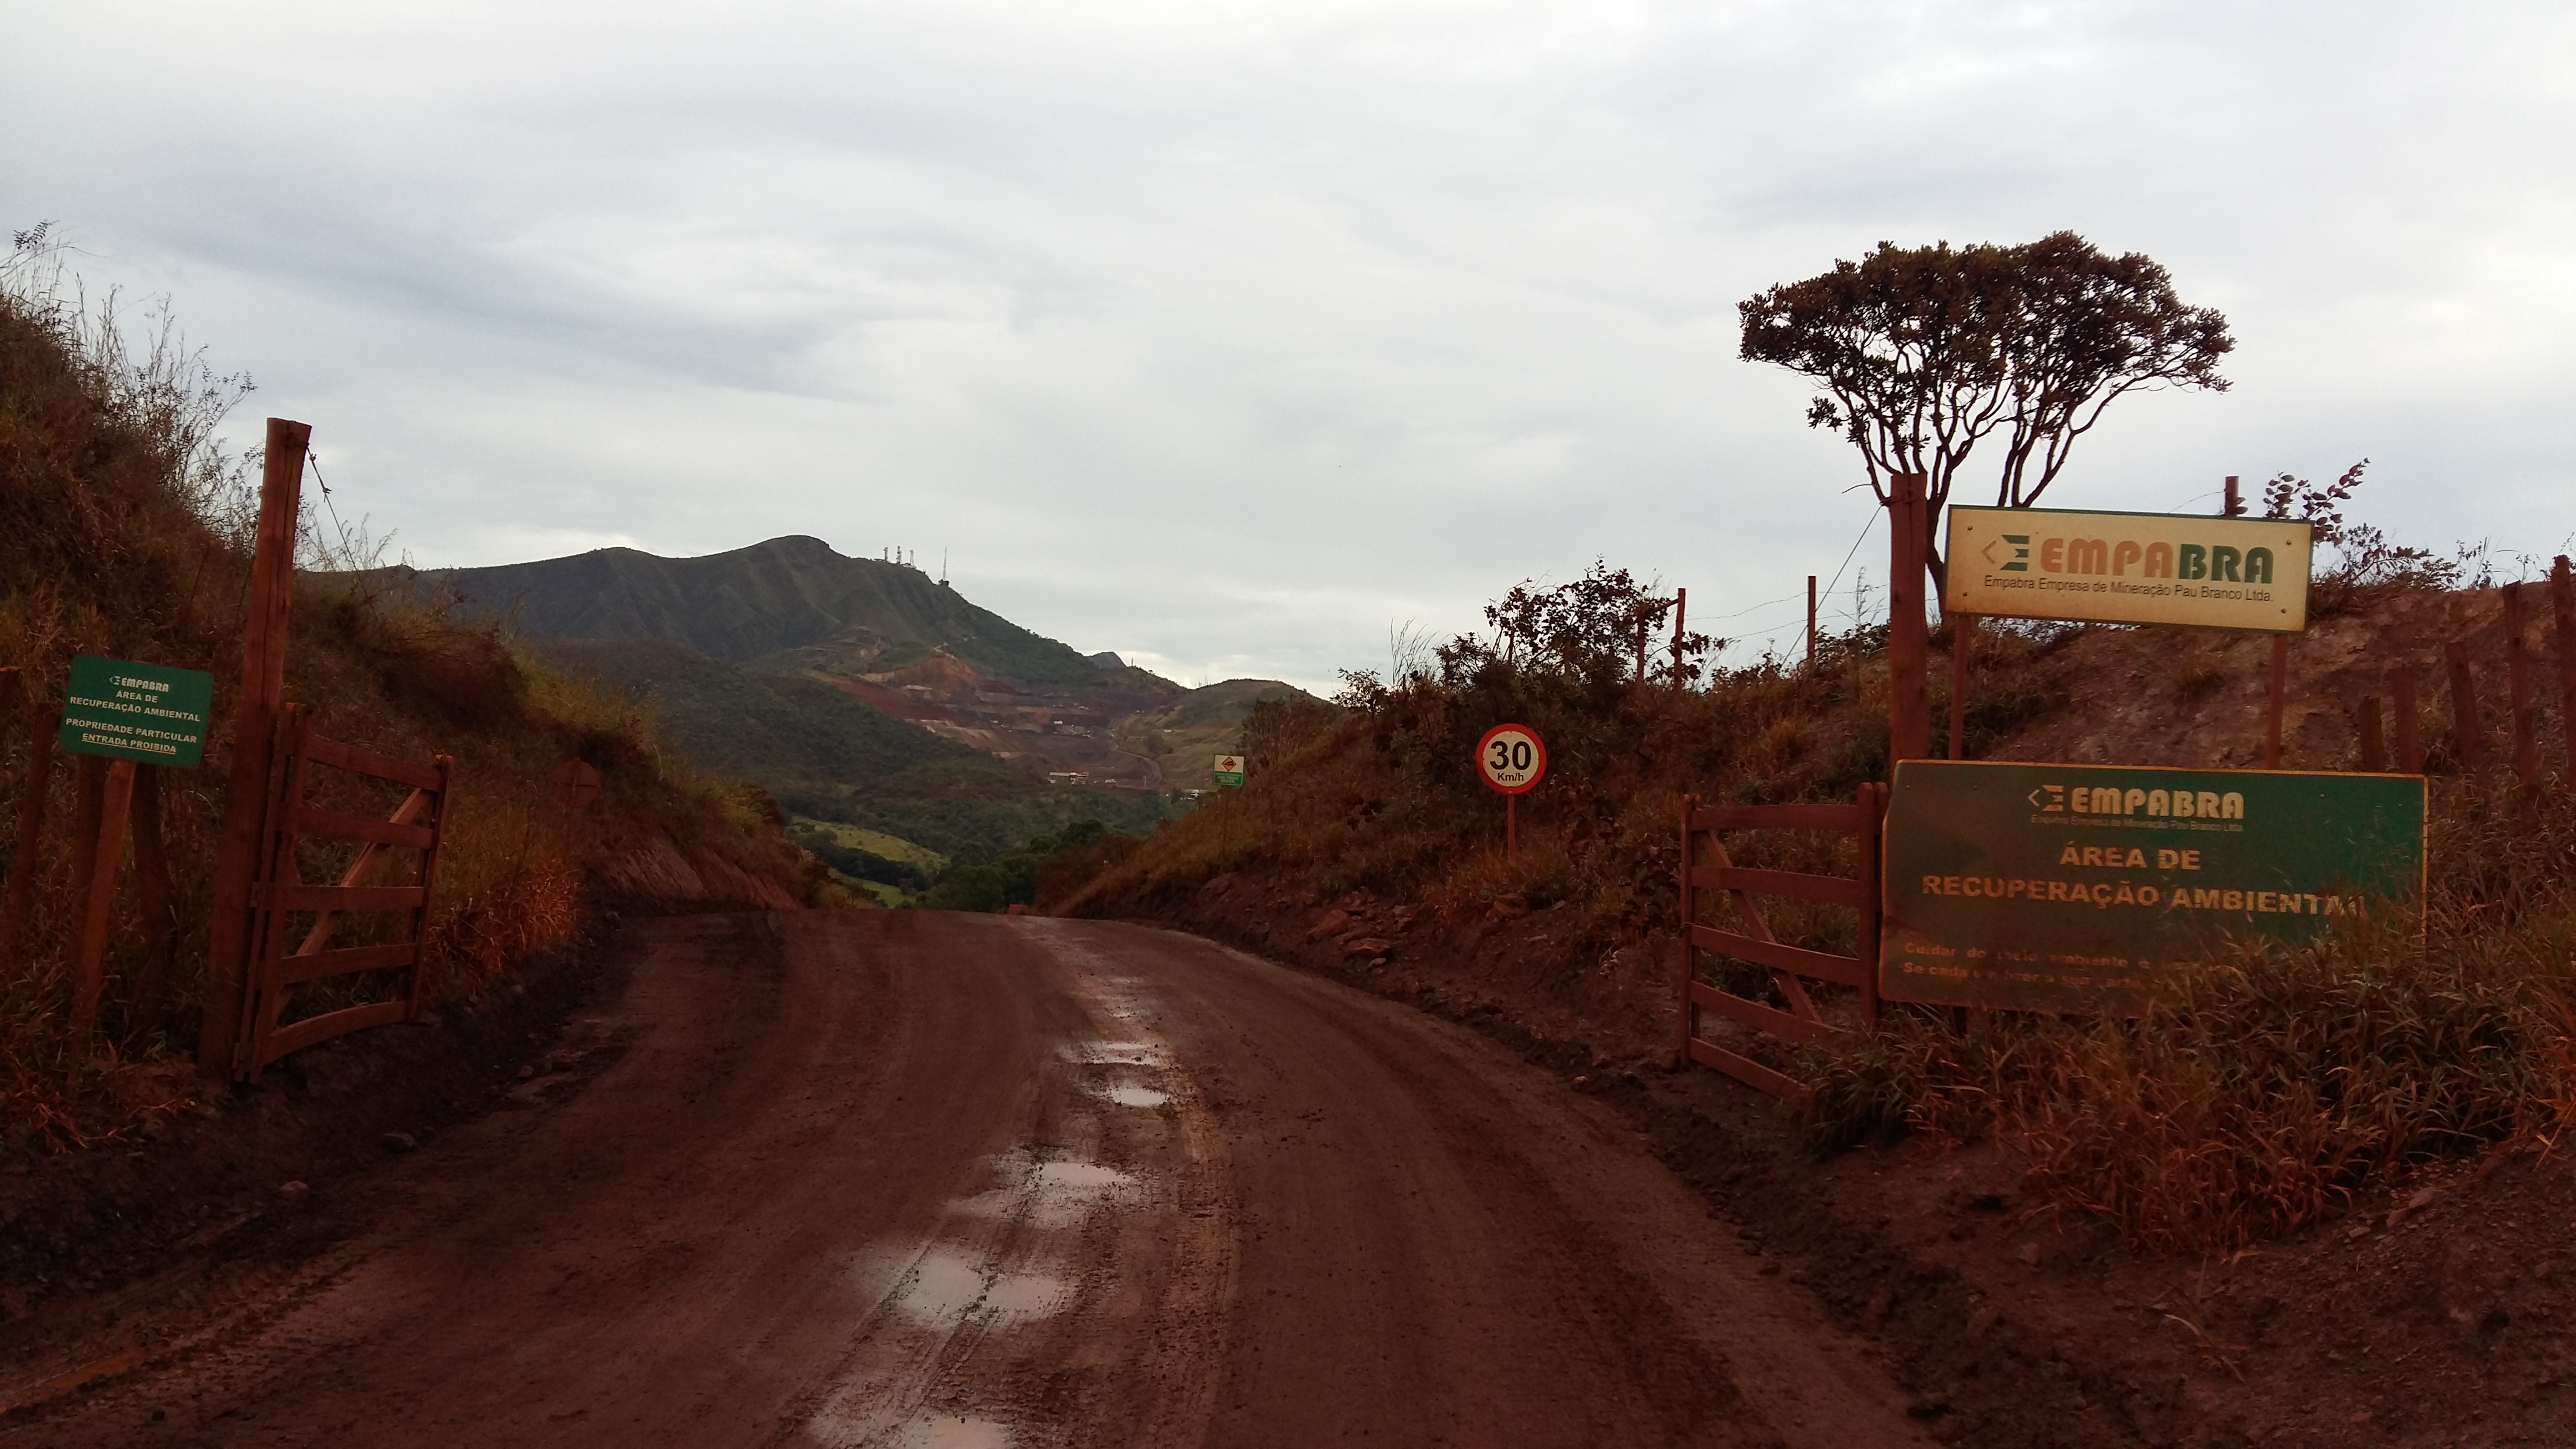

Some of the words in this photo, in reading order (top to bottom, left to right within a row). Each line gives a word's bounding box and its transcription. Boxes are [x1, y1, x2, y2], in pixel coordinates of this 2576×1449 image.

[2041, 537, 2274, 585] EMPABRA
[1984, 574, 2035, 590] Empabra
[2038, 577, 2089, 592] Empresa
[2092, 580, 2107, 592] de
[2110, 581, 2170, 598] Mineração
[2174, 584, 2197, 597] Pau
[2201, 586, 2242, 600] Branco
[2245, 588, 2273, 602] Ltda.
[115, 690, 142, 701] ÁREA
[145, 695, 159, 703] DE
[121, 677, 170, 692] EMPABRA
[69, 696, 142, 713] RECUPERAÇÃO
[144, 706, 200, 722] AMBIENTAL
[66, 718, 133, 734] PROPRIEDADE
[135, 728, 197, 743] PARTICULAR
[82, 733, 127, 746] ENTRADA
[130, 740, 177, 754] PROIBIDA
[1490, 741, 1531, 771] 30
[1497, 773, 1524, 781] Km/h
[2071, 786, 2245, 819] EMPABRA
[2059, 841, 2147, 869] ÁREA
[2158, 849, 2201, 871] DE
[1921, 875, 2160, 909] RECUPERAÇÃO
[1966, 945, 1987, 959] do
[1903, 961, 1924, 974] Se
[1928, 965, 1969, 978] cada
